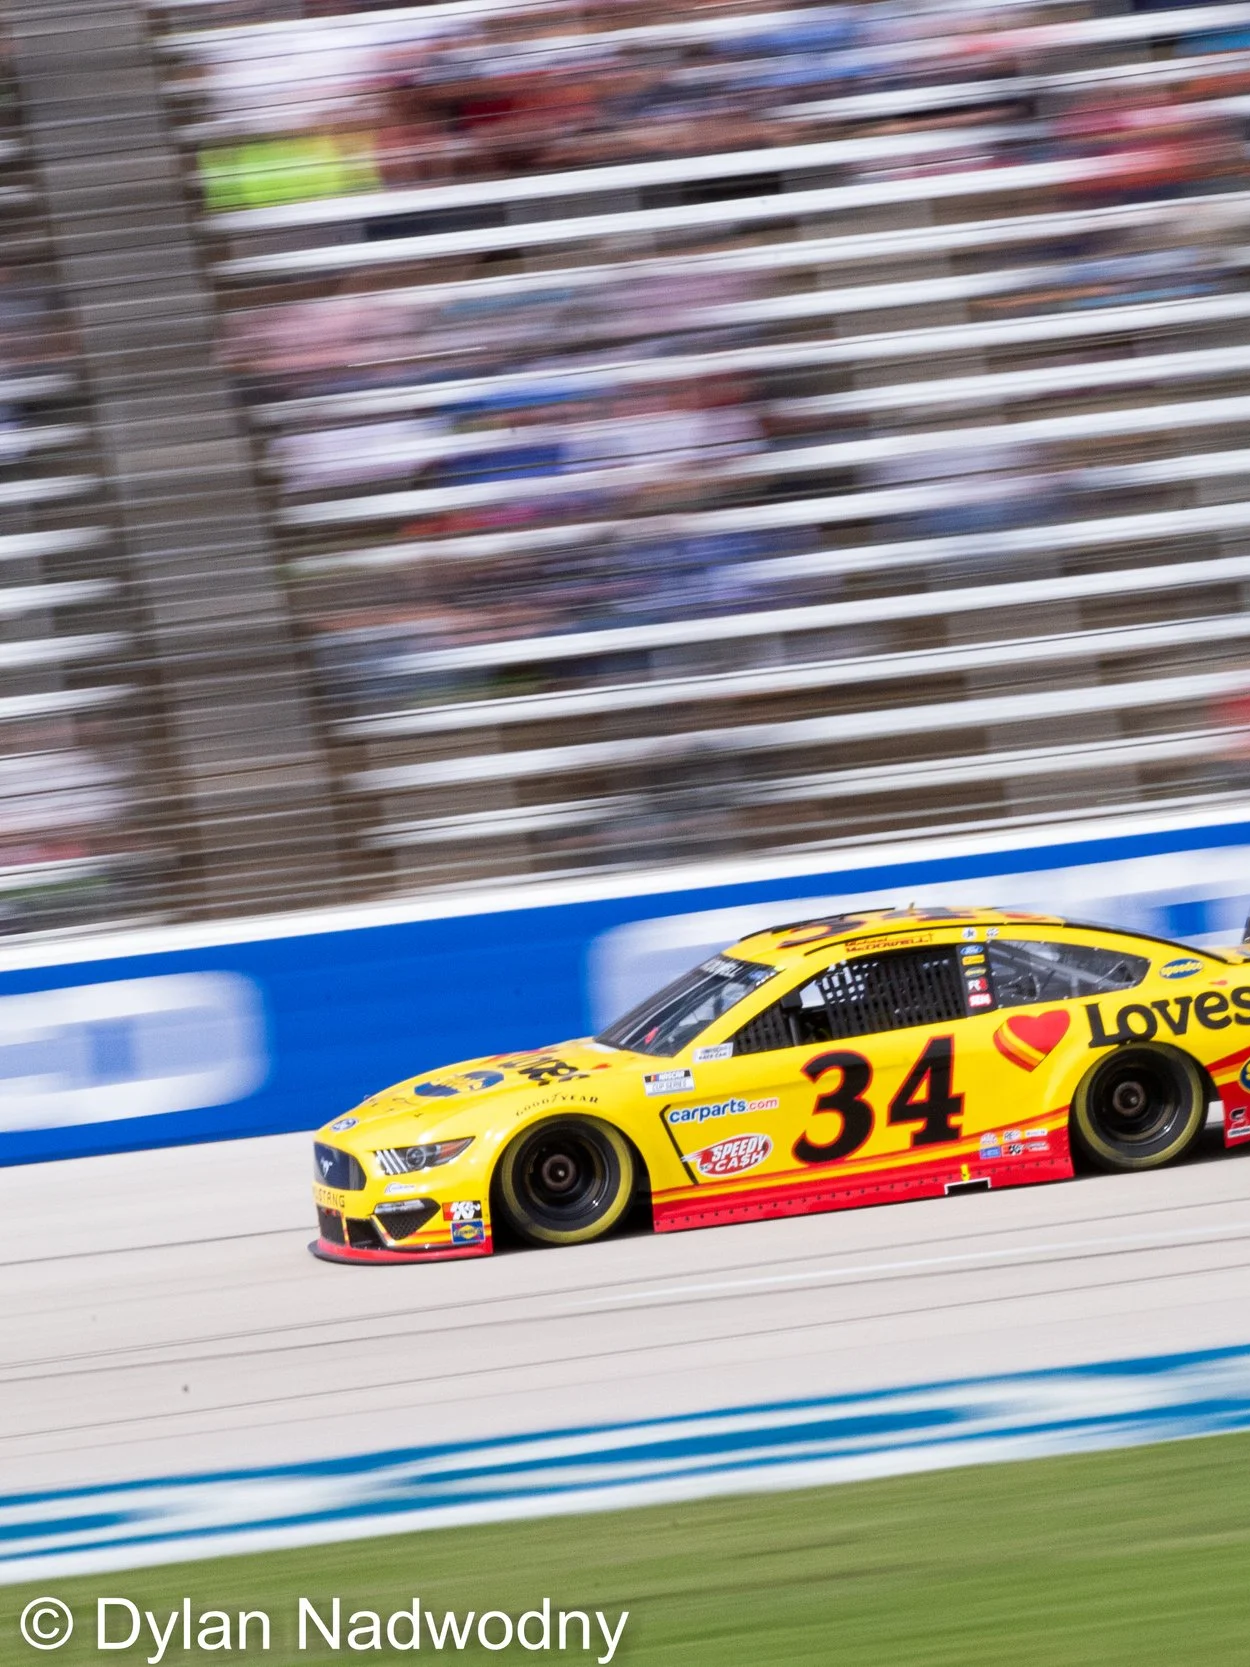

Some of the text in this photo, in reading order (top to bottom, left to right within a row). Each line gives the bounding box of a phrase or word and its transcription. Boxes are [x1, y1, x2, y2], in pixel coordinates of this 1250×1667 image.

[669, 1098, 778, 1123] carparts.com
[791, 1033, 965, 1165] 34
[711, 1135, 767, 1162] SPEEDY
[313, 1188, 345, 1209] STANG
